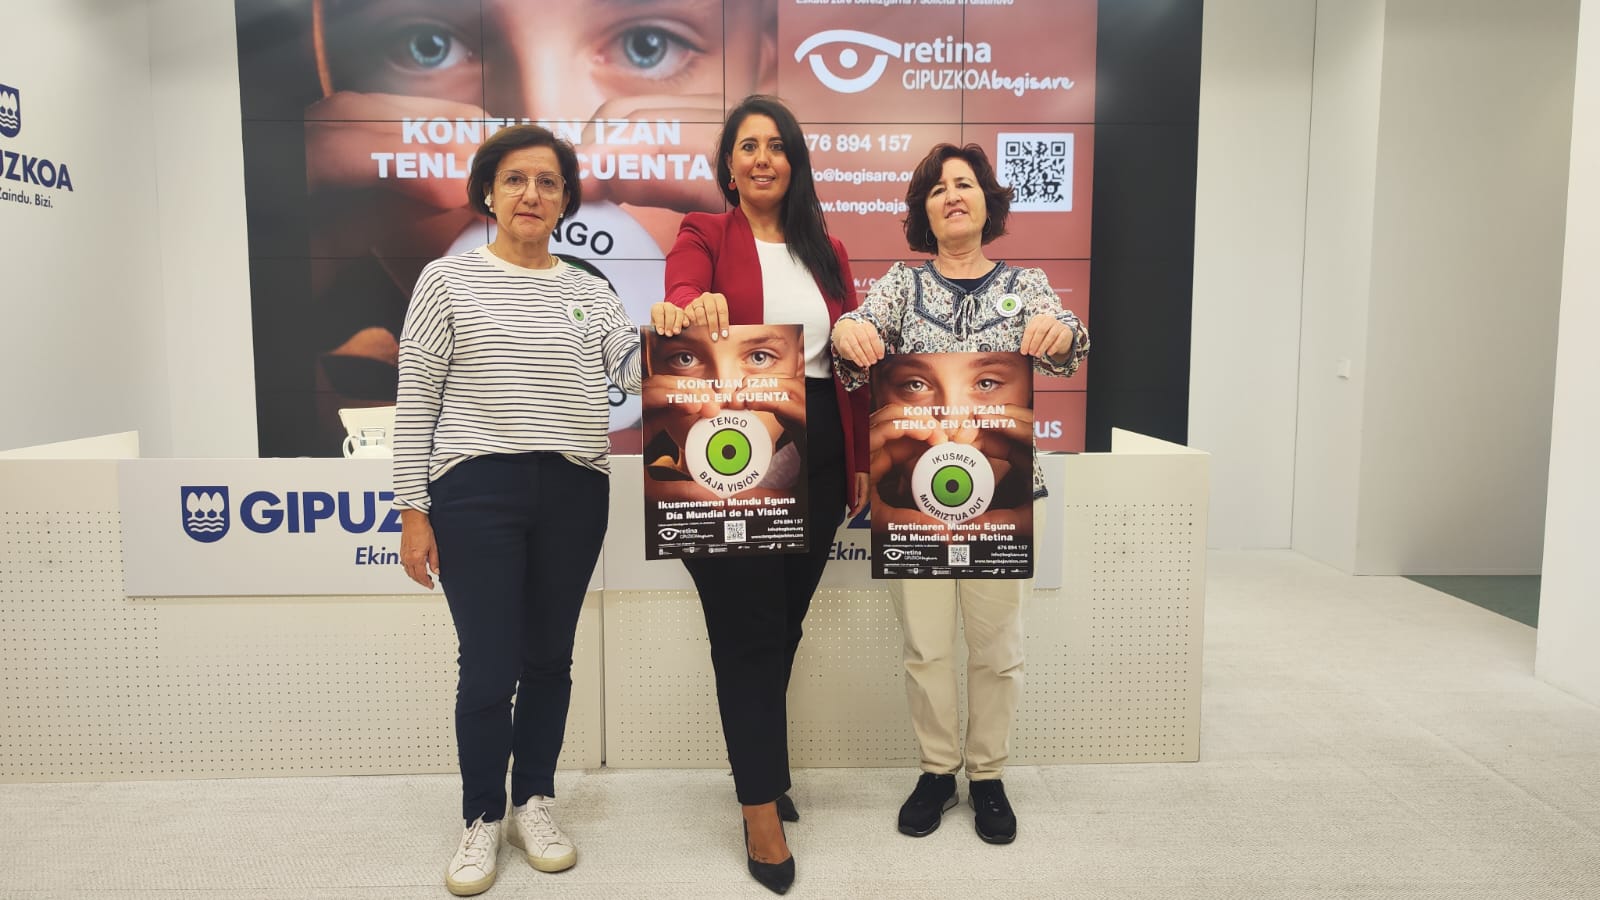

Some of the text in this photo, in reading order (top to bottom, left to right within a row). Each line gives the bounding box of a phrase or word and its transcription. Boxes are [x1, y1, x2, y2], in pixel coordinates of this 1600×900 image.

[903, 35, 992, 63] retina
[595, 118, 681, 145] IZAN
[804, 134, 912, 152] 76 894 157
[0, 149, 73, 192] ZKOA
[371, 153, 473, 179] TENL
[35, 193, 53, 208] Bizi.
[677, 378, 778, 389] KONTUAN IZAN
[666, 391, 790, 404] TENLO EN CUENTA
[903, 404, 1005, 416] KONTUAN IZAN
[710, 416, 748, 428] TENGO
[893, 418, 1016, 430] TENLO EN CUENTA
[932, 452, 976, 468] IKUSMEN
[699, 471, 724, 491] BAJA
[658, 496, 796, 510] Ikusmenaren Mundu Eguna
[920, 493, 984, 521] MURRIZTUA DUT
[240, 491, 403, 533] GIPUZ
[666, 507, 789, 520] Día Mundial de la Visión
[887, 522, 1016, 531] Erretinaren Mundu Eguna
[890, 533, 1014, 541] Día Mundial de la Retina
